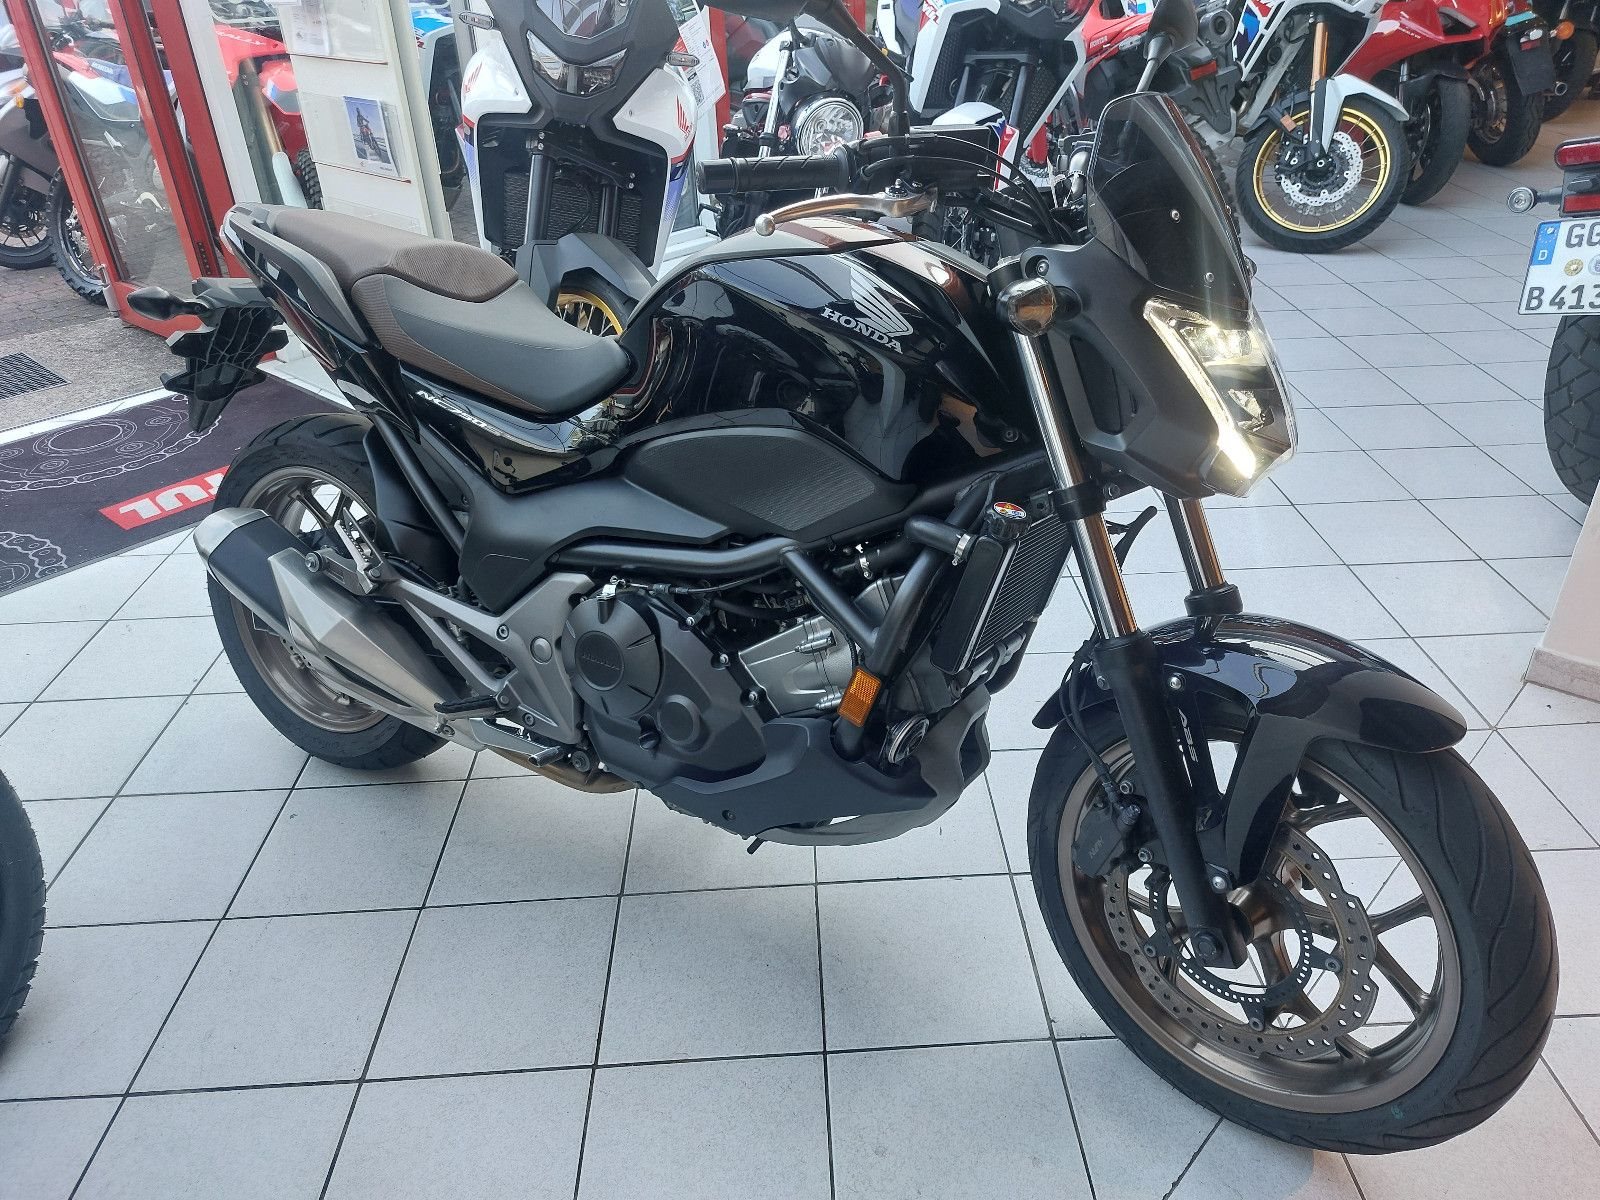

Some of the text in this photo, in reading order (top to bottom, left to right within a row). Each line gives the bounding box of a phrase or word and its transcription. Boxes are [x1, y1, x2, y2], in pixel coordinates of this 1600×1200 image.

[1538, 249, 1548, 260] D
[1525, 286, 1545, 310] B
[821, 306, 904, 355] HONDA
[1177, 706, 1199, 763] ABS
